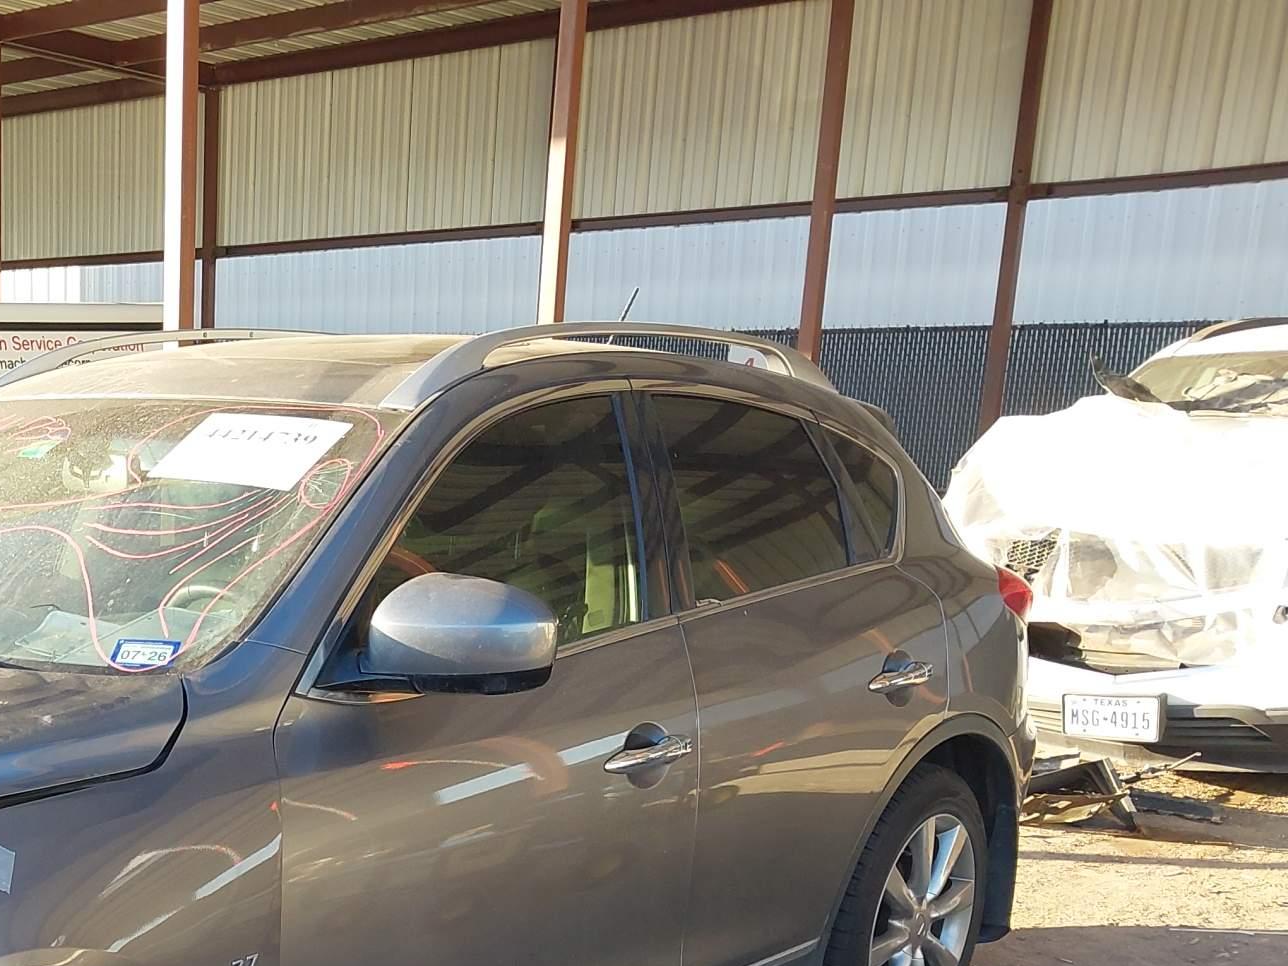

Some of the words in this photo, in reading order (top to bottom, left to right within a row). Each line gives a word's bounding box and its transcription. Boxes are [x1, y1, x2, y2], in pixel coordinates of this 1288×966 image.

[12, 336, 63, 351] Service
[120, 649, 141, 660] 07
[147, 651, 168, 662] 26
[1093, 698, 1128, 707] TEXAS
